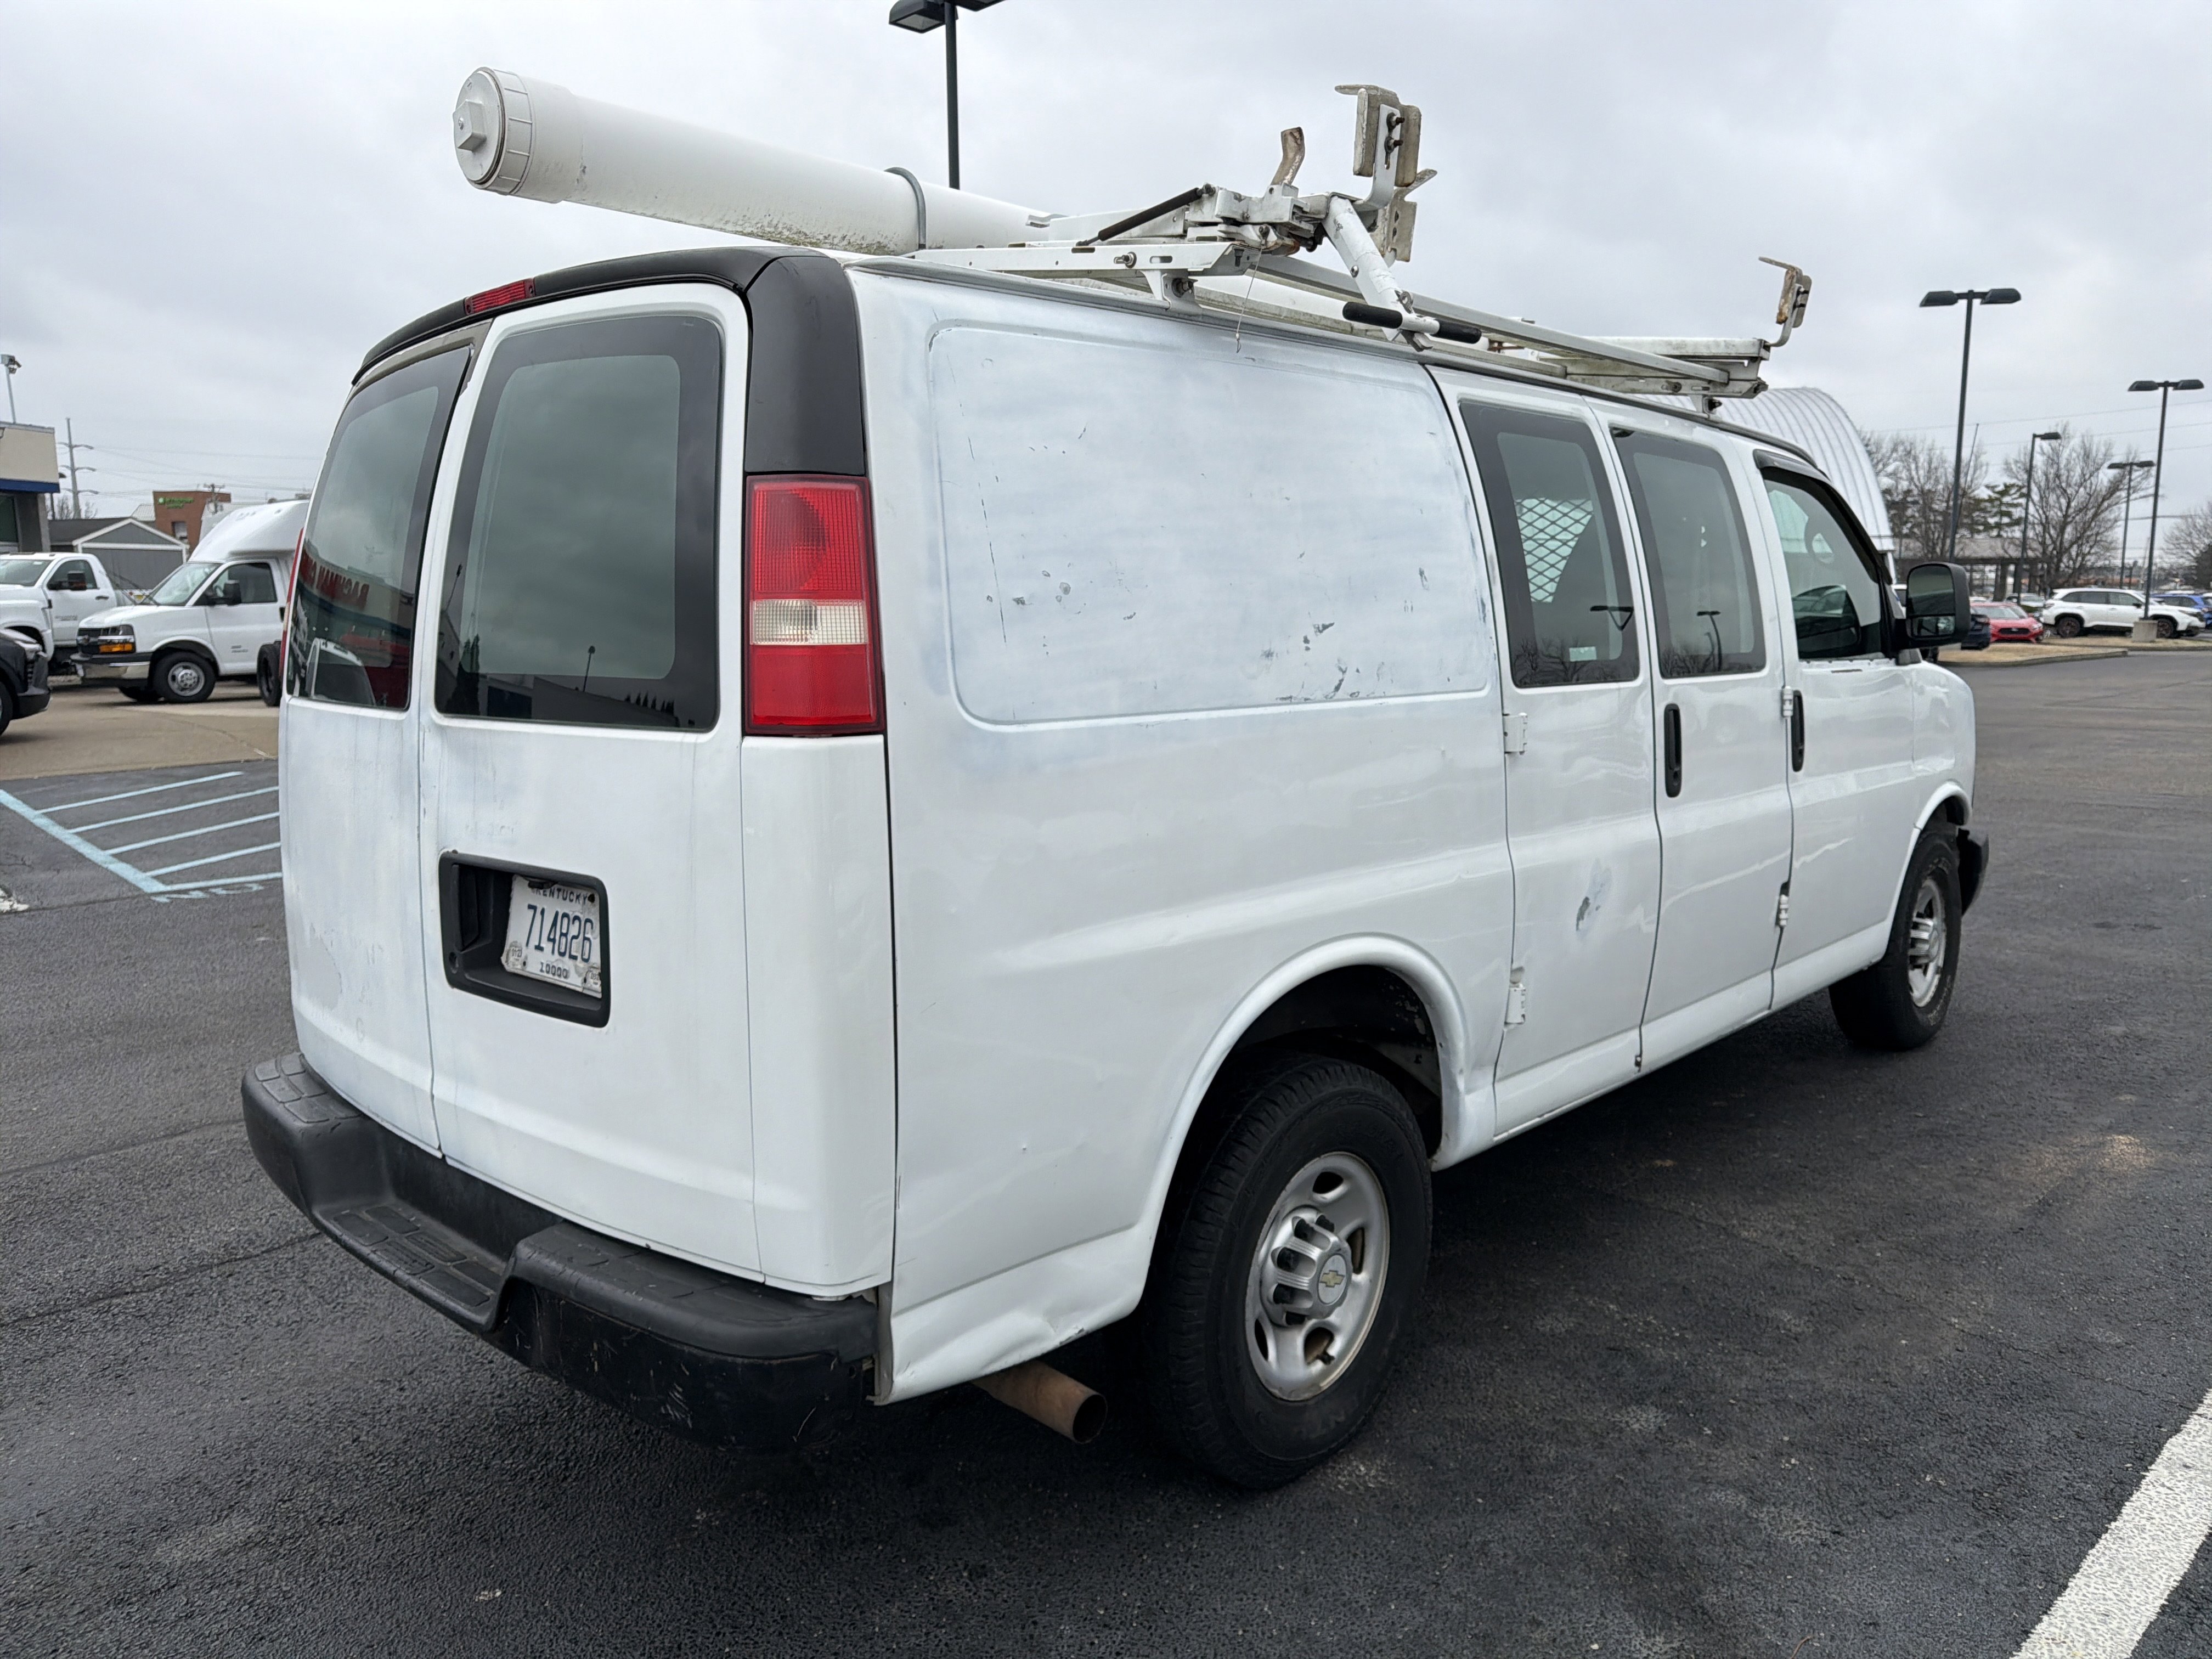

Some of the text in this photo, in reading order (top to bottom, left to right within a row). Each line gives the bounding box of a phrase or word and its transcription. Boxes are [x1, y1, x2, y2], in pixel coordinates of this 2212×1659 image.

[535, 887, 588, 905] KENTUCKY
[526, 904, 594, 963] 714826
[539, 961, 568, 979] 10000
